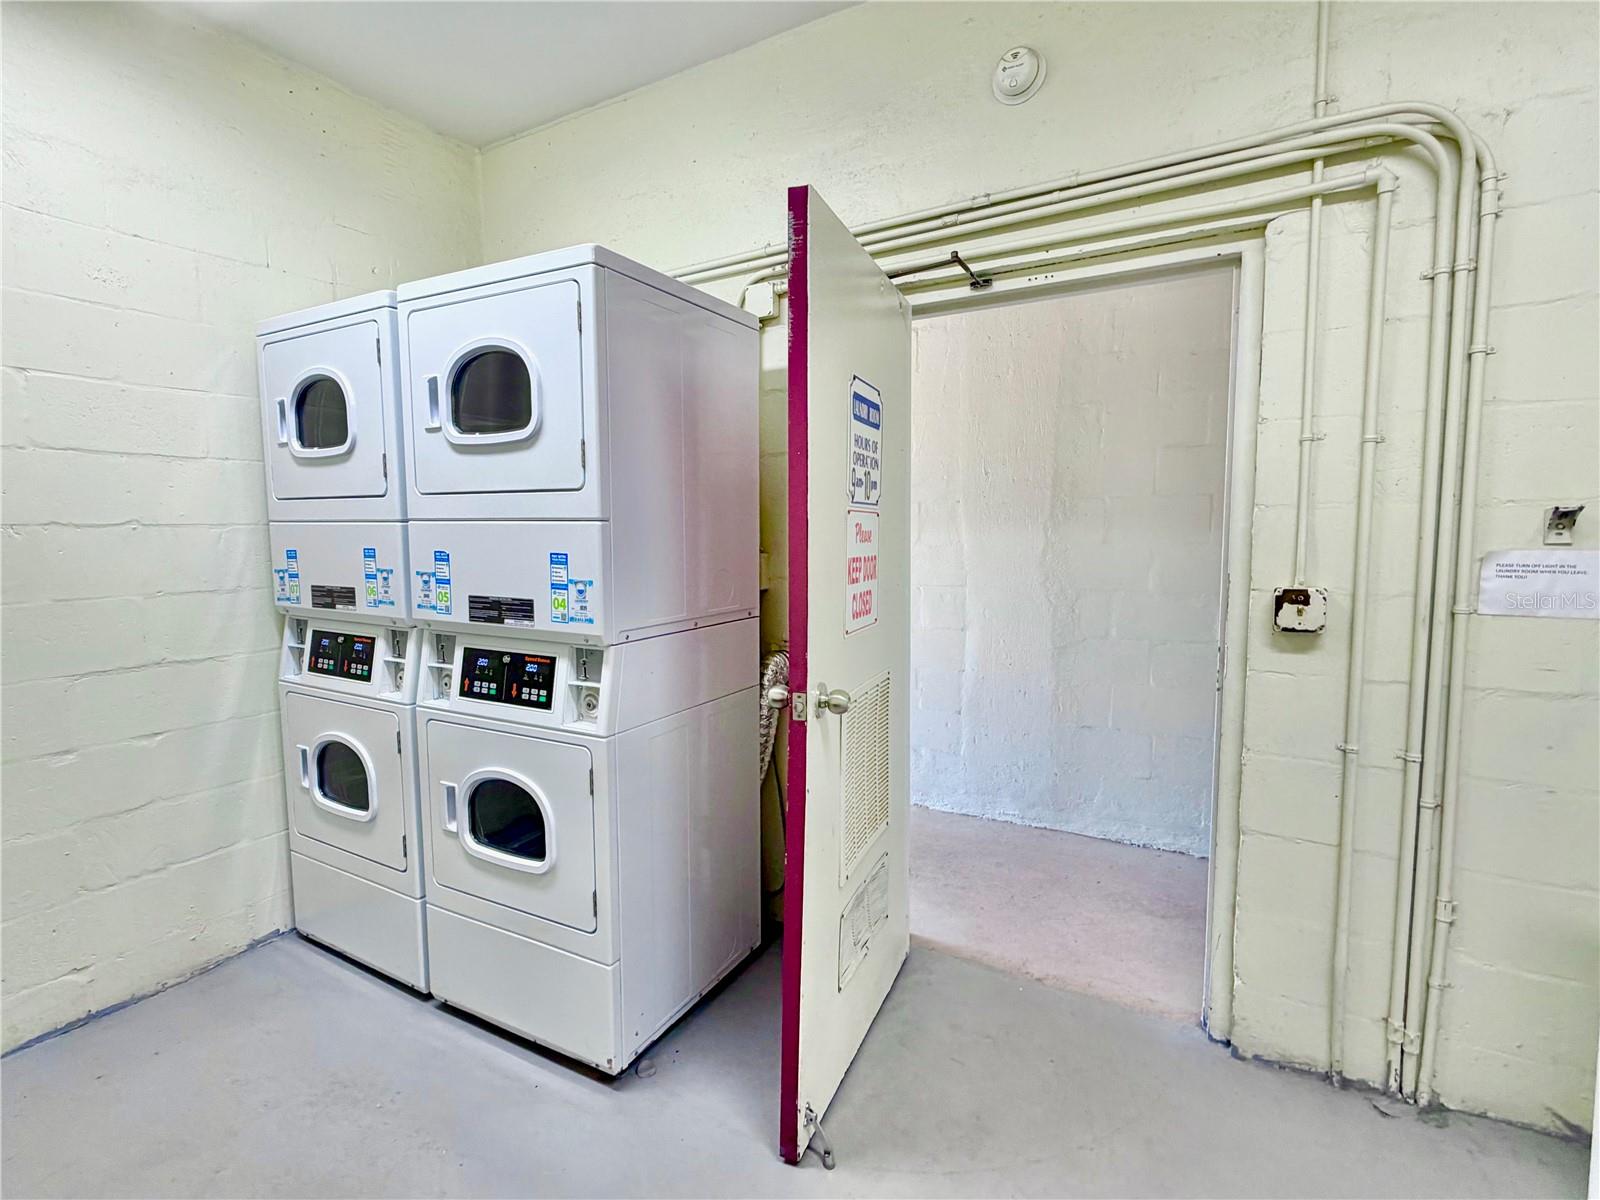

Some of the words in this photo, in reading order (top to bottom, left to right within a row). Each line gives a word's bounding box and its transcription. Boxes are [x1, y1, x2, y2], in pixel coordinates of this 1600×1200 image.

[854, 433, 871, 453] HOURS
[871, 440, 879, 455] OF
[852, 451, 879, 471] OPERATION
[855, 522, 872, 544] Please
[848, 556, 862, 585] KEEP
[863, 555, 877, 582] DOOR
[367, 586, 376, 597] 06
[437, 591, 449, 603] 05
[553, 597, 566, 610] 04
[852, 589, 872, 621] CLOSED
